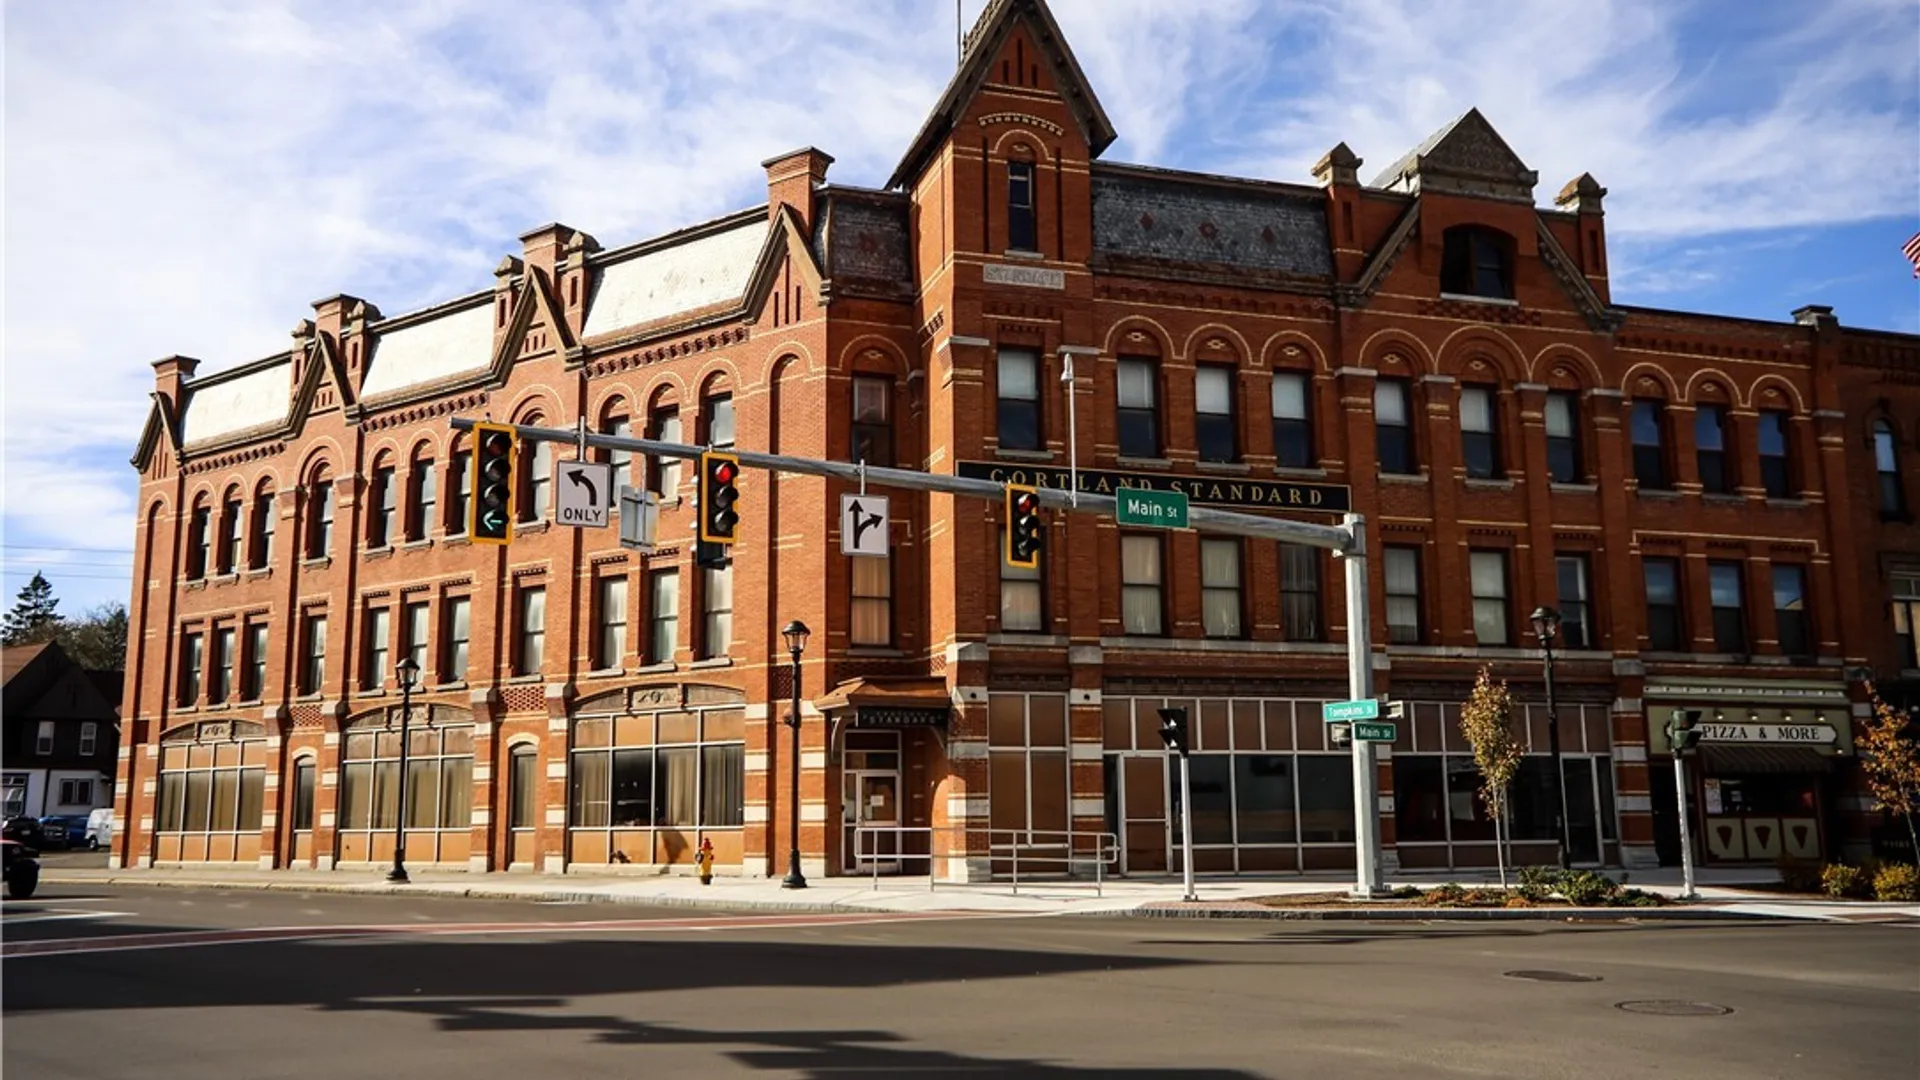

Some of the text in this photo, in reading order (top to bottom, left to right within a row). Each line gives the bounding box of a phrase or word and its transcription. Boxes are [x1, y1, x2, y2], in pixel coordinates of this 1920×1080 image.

[989, 468, 1322, 505] CORTLAND STANDARD
[563, 507, 601, 522] ONLY
[1127, 498, 1178, 518] Main St
[1328, 706, 1364, 718] Tompkins
[1359, 726, 1392, 738] Main St
[1702, 724, 1821, 741] PIZZA & MORE
